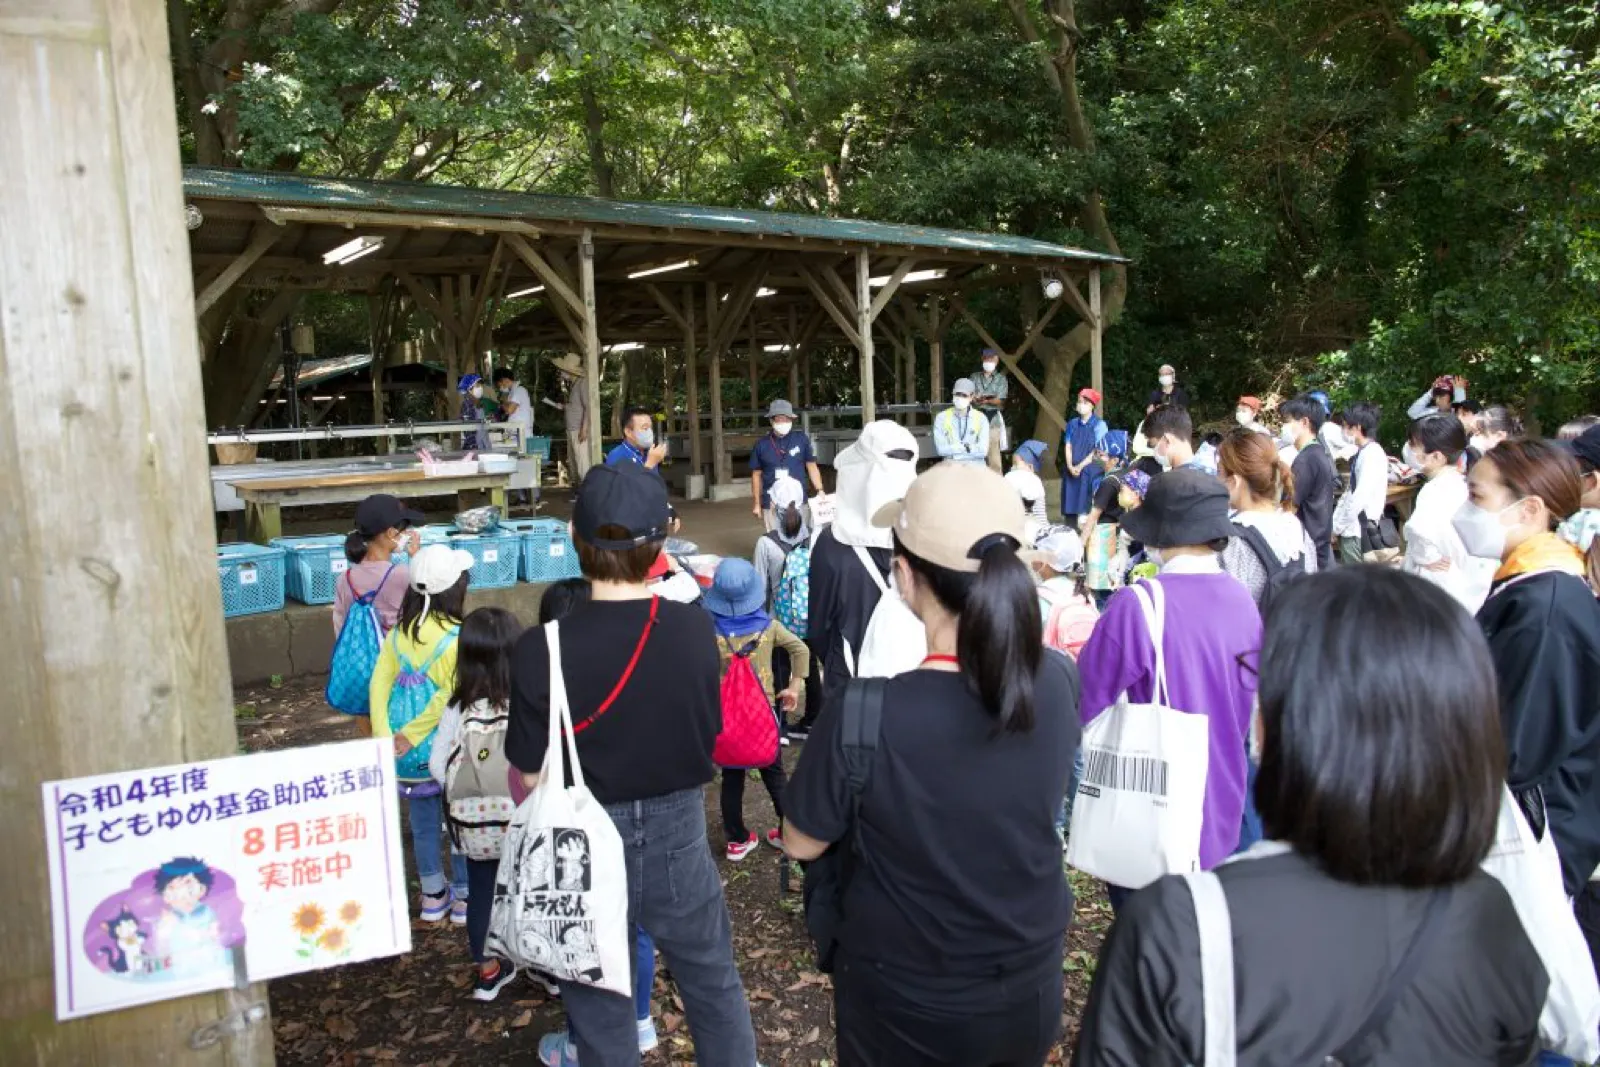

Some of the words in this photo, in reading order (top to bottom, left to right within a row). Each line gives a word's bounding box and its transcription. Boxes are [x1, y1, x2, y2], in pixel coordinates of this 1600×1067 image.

[59, 767, 209, 817] 令和4年度
[64, 764, 384, 851] 子どもゆめ基金助成活動
[242, 812, 368, 856] 8月活動
[258, 850, 352, 892] 実施中
